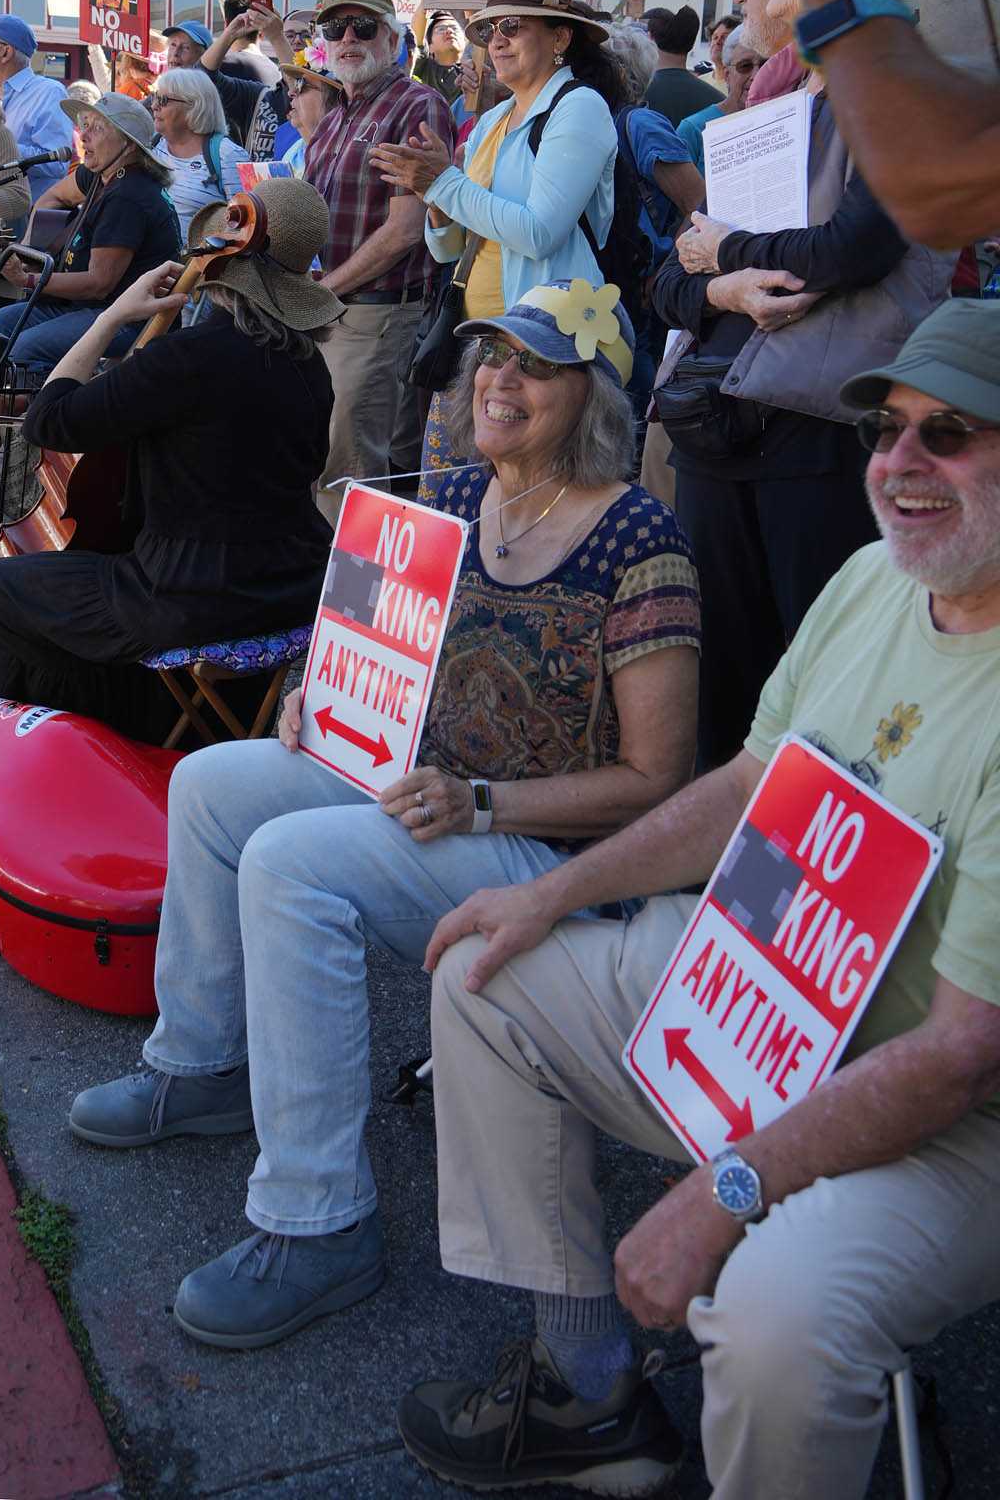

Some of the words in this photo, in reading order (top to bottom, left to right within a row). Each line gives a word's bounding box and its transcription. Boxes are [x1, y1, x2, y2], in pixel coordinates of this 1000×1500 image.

[91, 6, 120, 30] NO
[397, 0, 416, 13] DOGE
[102, 28, 142, 55] KING
[736, 140, 745, 149] NO
[736, 150, 745, 160] THE
[746, 140, 770, 156] WORKING
[770, 132, 789, 145] CLASS
[711, 161, 733, 175] AGAINST
[373, 513, 415, 573] NO
[372, 577, 440, 652] KING
[317, 640, 416, 726] ANYTIME
[796, 790, 865, 885] NO
[772, 879, 876, 1008] KING
[681, 937, 814, 1102] ANYTIME
